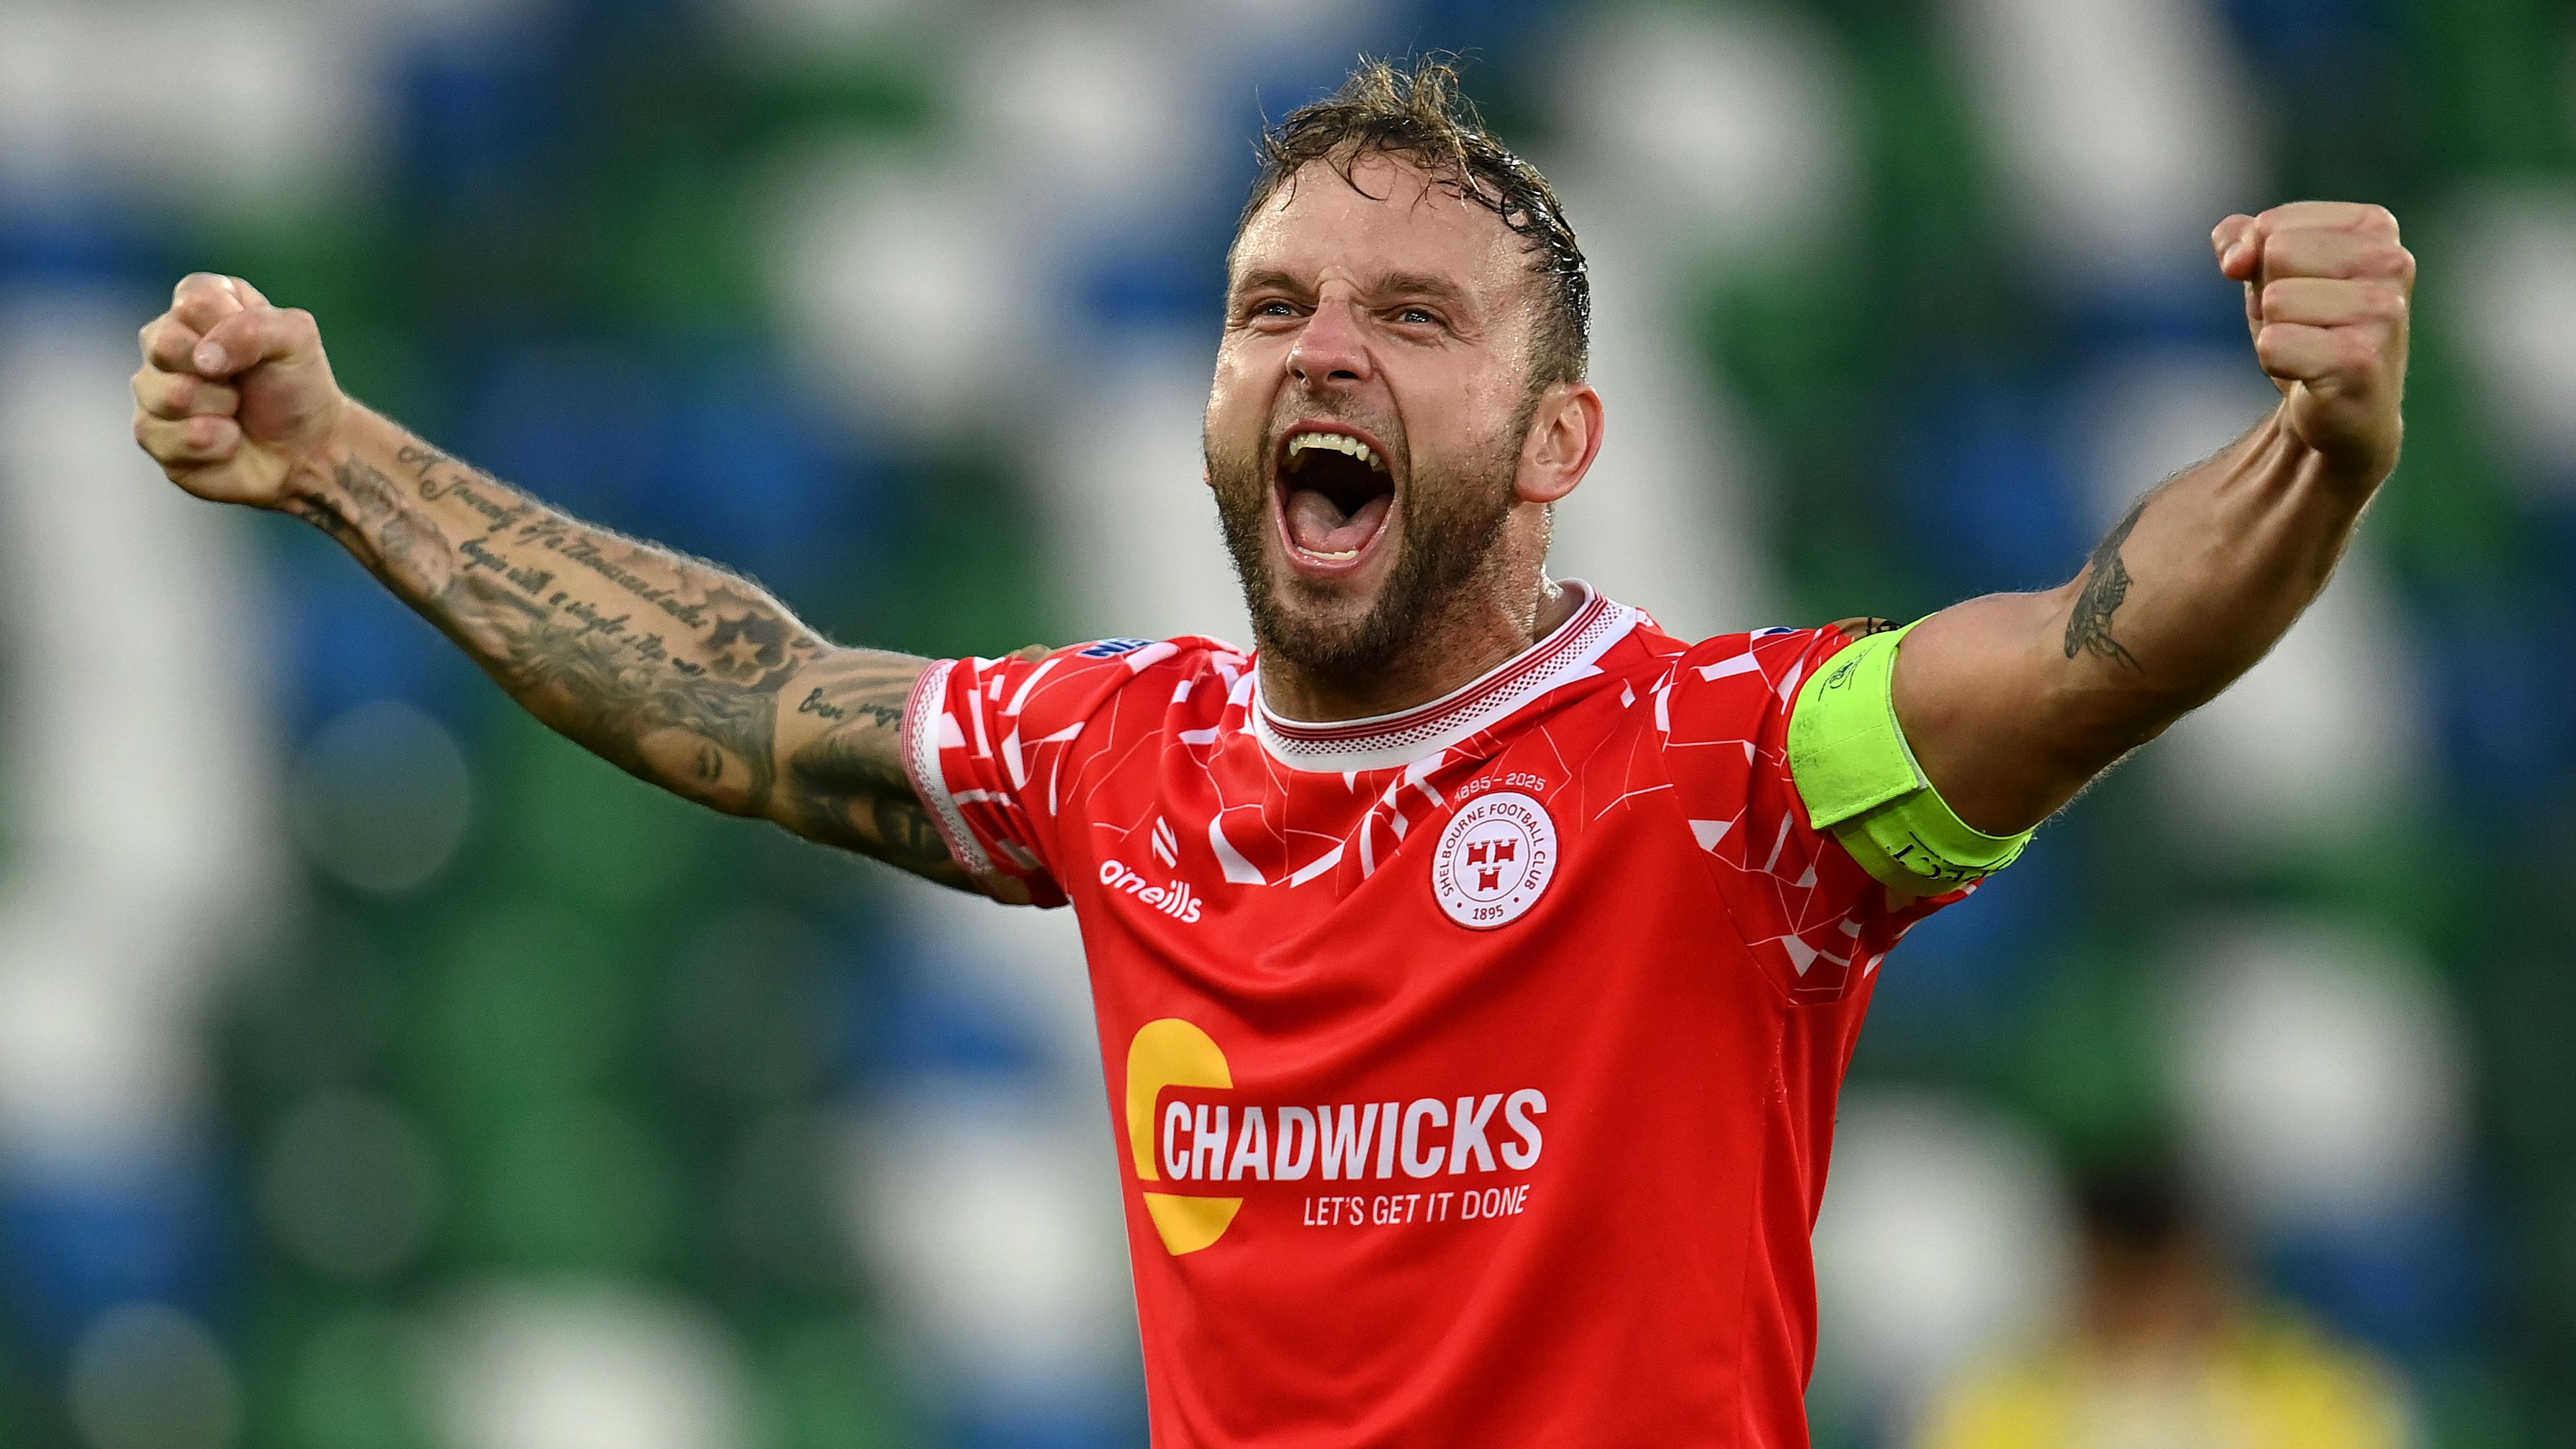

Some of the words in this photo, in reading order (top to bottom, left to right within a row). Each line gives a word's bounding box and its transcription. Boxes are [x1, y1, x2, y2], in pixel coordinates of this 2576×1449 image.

[1439, 805, 1486, 897] SHELBOURNE
[1488, 803, 1545, 847] FOOTBALL
[1524, 850, 1546, 890] CLUB
[1471, 904, 1504, 921] 1895
[1162, 1088, 1548, 1181] CHADWICKS
[1303, 1196, 1365, 1227] LET'S
[1372, 1193, 1421, 1225] GET
[1425, 1191, 1455, 1223] IT
[1461, 1183, 1531, 1221] DONE
